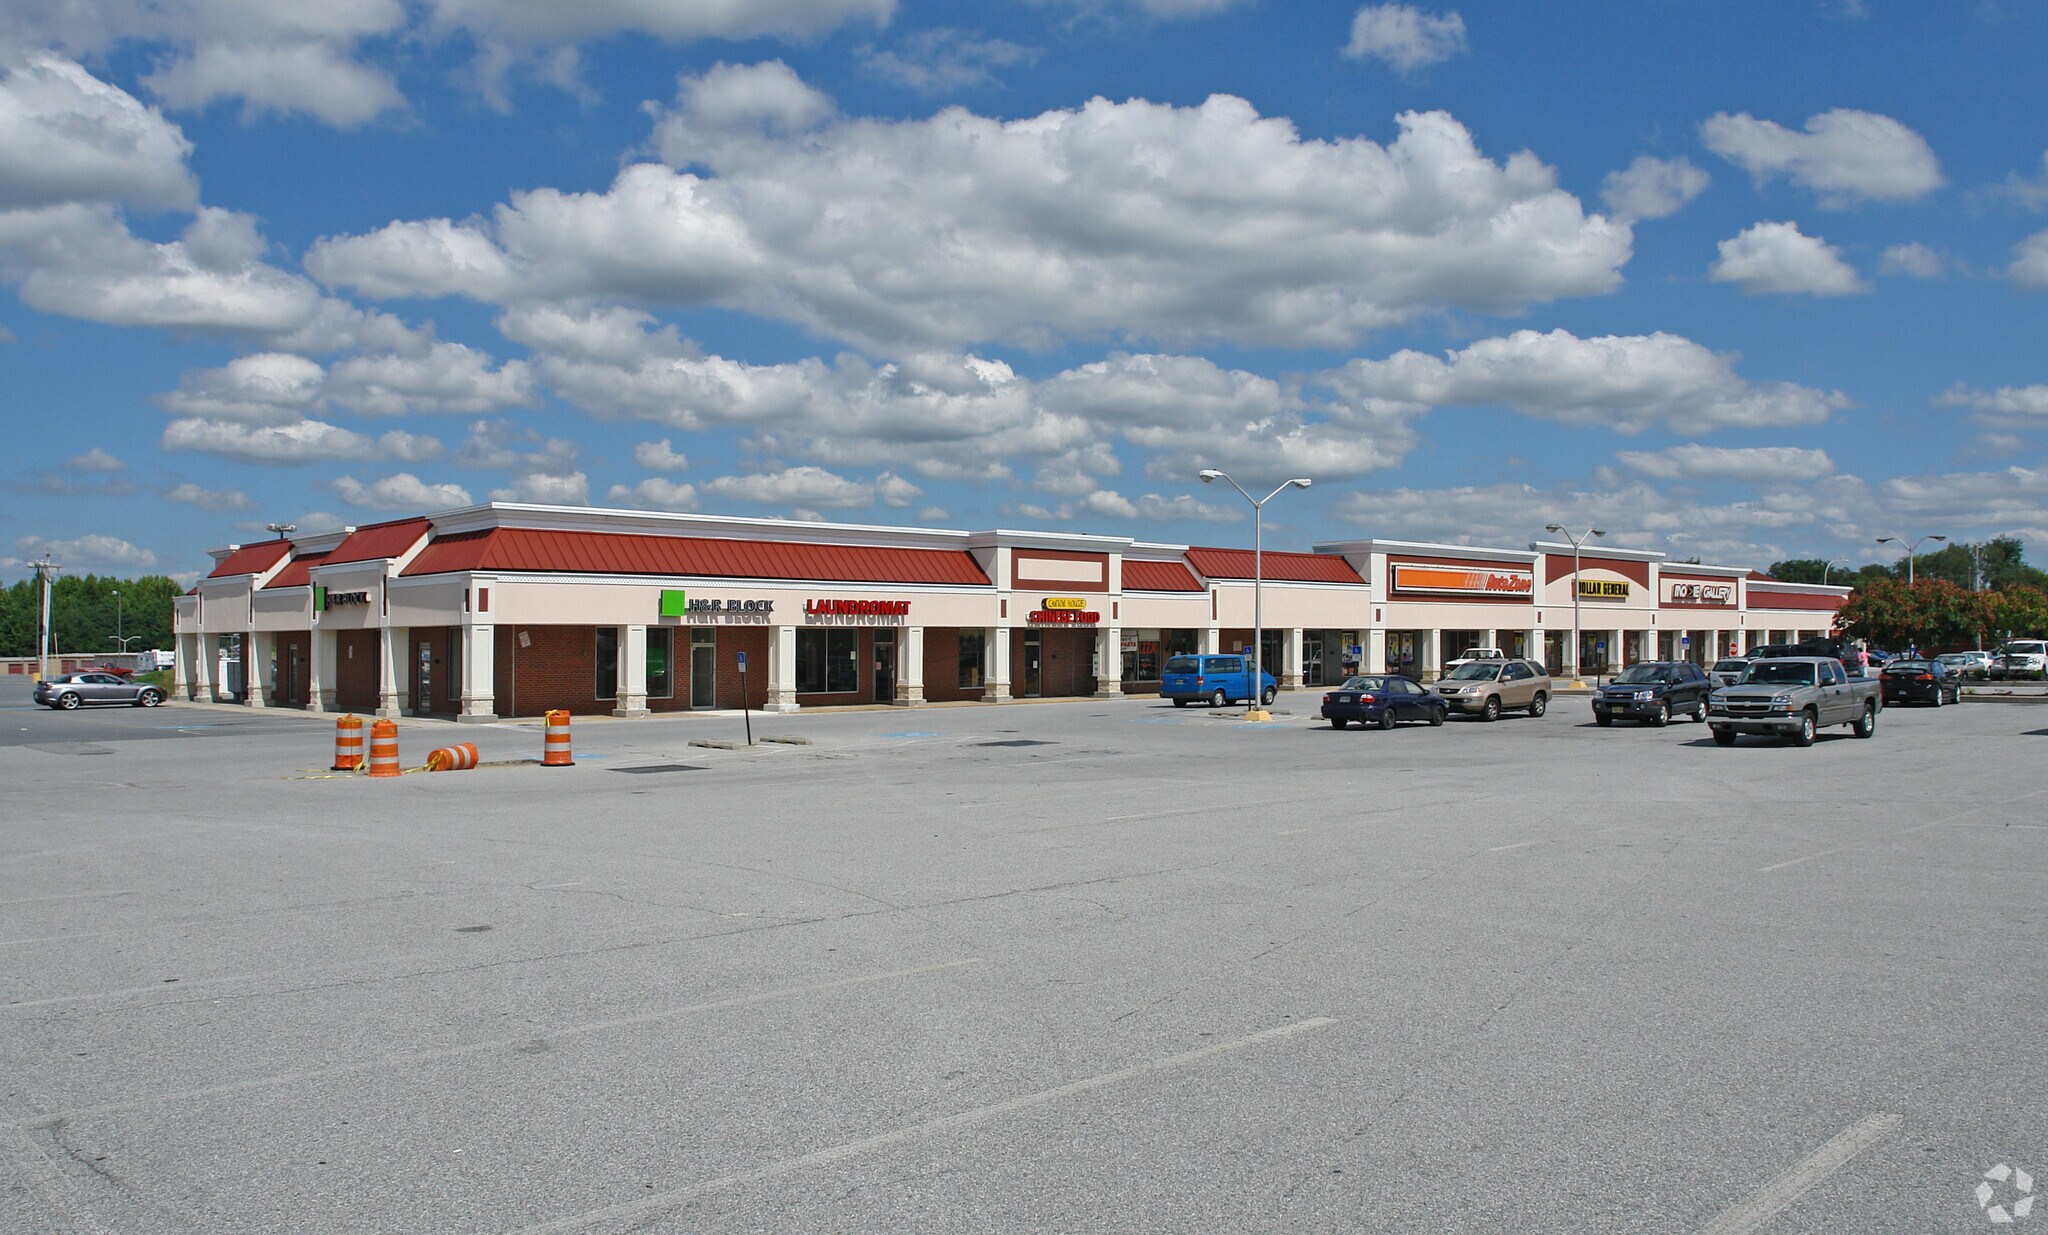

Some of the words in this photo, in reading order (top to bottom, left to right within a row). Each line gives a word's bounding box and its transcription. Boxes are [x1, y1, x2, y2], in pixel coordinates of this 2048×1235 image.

[1485, 573, 1532, 592] AutoZone
[1578, 581, 1602, 595] DOLLAR
[1603, 583, 1630, 596] GENERAL
[1702, 585, 1731, 602] GALLERY
[689, 599, 722, 612] H&R
[727, 600, 774, 613] BLOCK
[806, 599, 912, 616] LAUNDROMAT
[1030, 611, 1074, 623] CHINESE
[1075, 611, 1101, 623] FOOD
